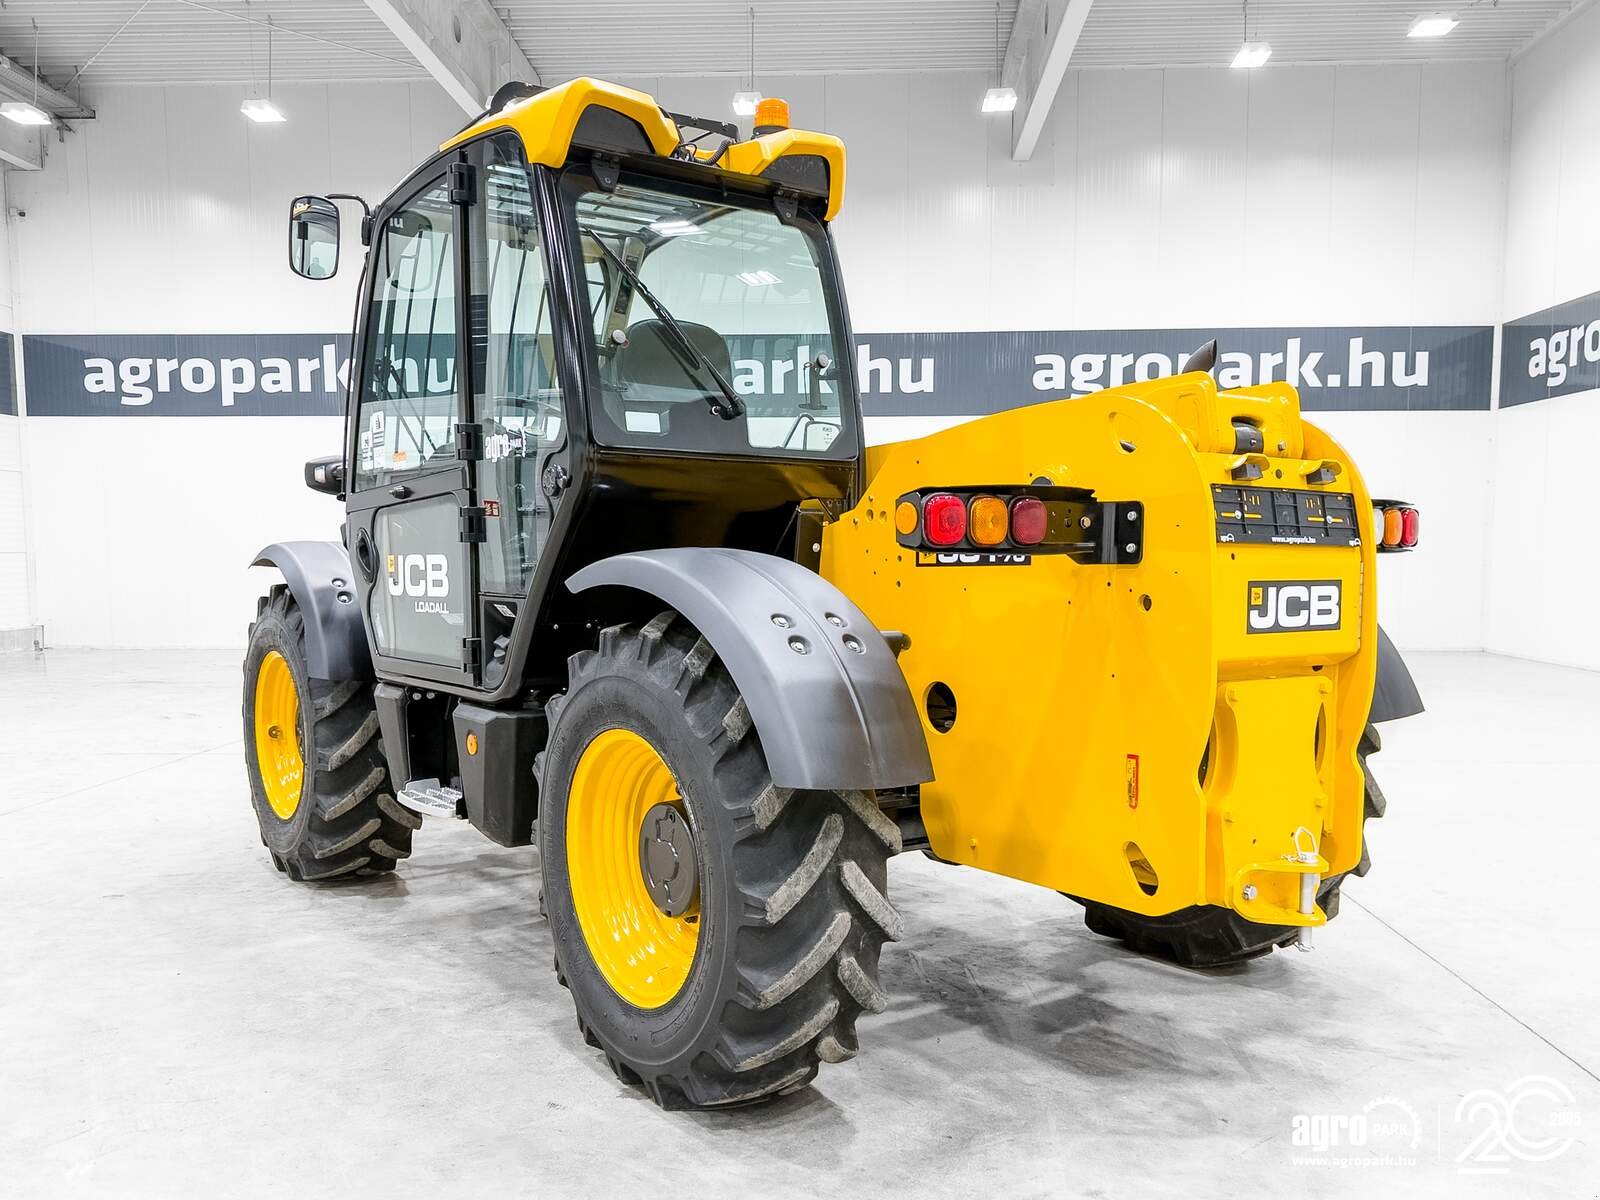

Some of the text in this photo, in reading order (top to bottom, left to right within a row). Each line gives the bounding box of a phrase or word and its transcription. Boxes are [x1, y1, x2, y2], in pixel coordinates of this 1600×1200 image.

[83, 343, 458, 407] agroparkhu
[1271, 535, 1316, 545] www.agropark.hu
[388, 554, 449, 597] JCB
[415, 602, 449, 614] LOADALL
[1249, 585, 1340, 629] JCB
